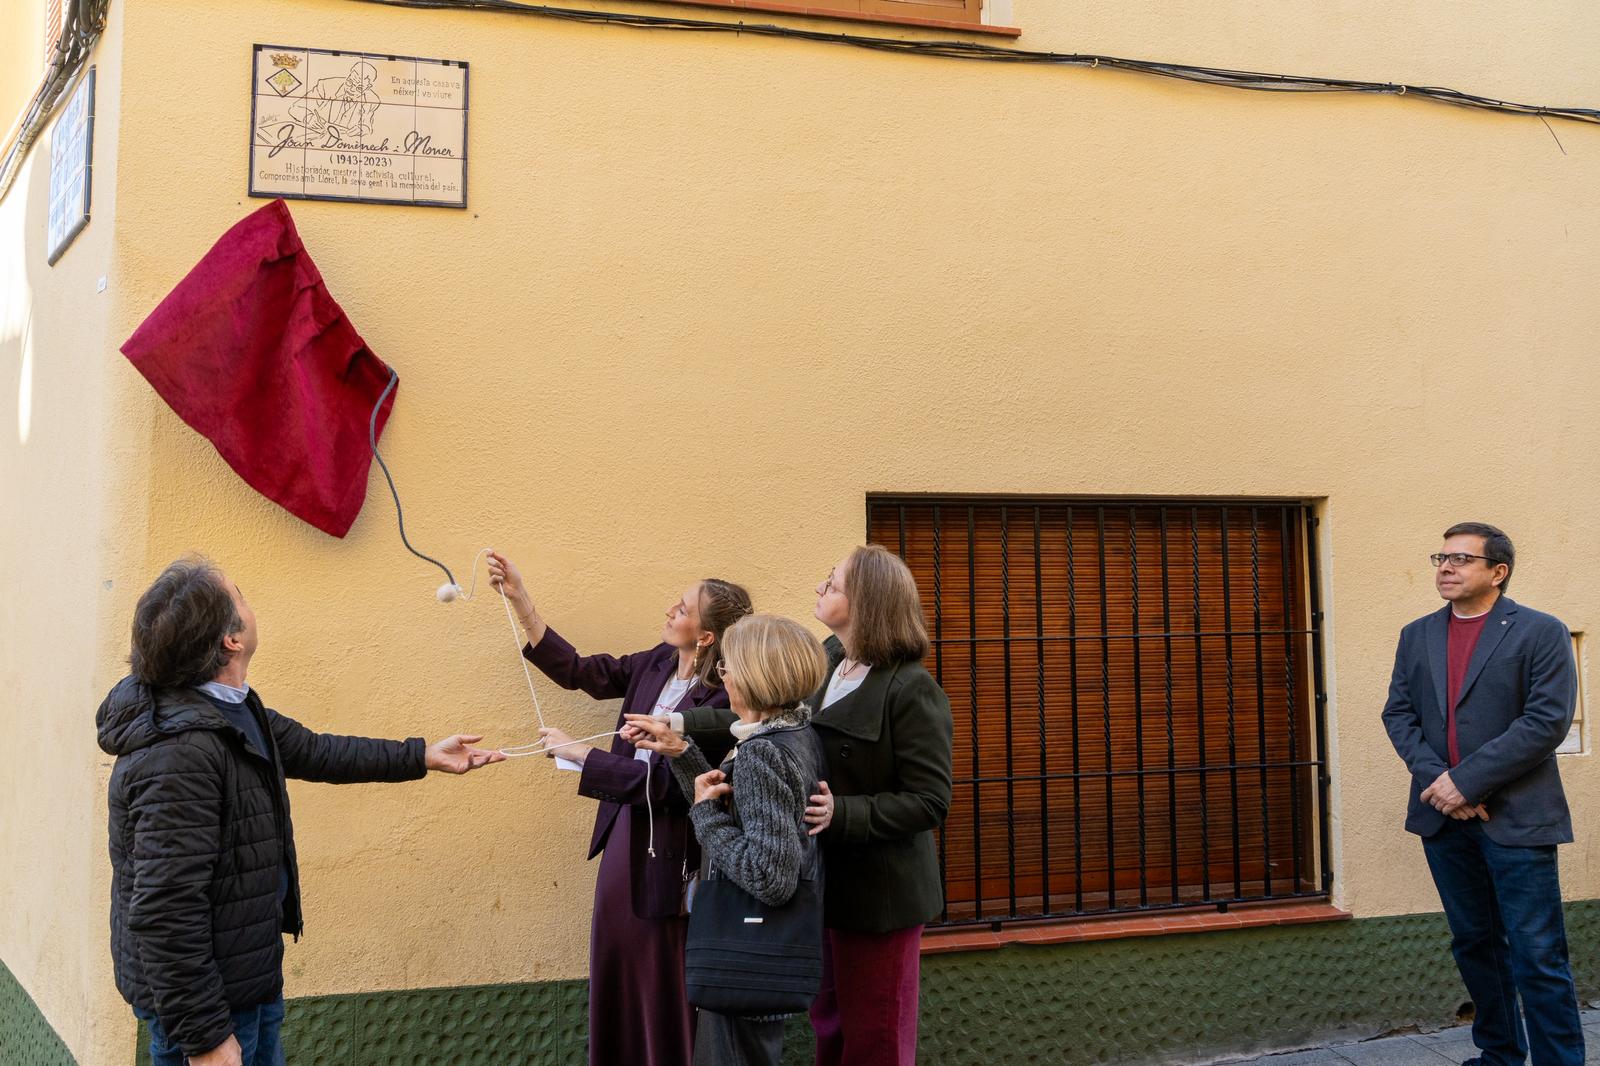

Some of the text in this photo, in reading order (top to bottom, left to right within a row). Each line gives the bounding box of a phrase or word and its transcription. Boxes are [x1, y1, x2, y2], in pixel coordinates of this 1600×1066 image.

[391, 75, 400, 84] En
[402, 77, 430, 87] aquesta
[432, 80, 449, 88] casa
[422, 90, 431, 98] va
[432, 90, 452, 99] viure
[268, 124, 314, 158] Joan
[321, 125, 389, 151] Domènech
[404, 130, 455, 157] Moner
[330, 153, 392, 167] (1943-2023)
[285, 162, 331, 175] Historiador,
[333, 168, 357, 177] mestre
[366, 169, 394, 179] activista
[398, 171, 435, 181] cultural.
[301, 174, 315, 182] amb
[318, 174, 340, 184] Lloret,
[341, 176, 348, 184] la
[350, 178, 367, 186] seva
[368, 180, 383, 189] gent
[391, 179, 398, 188] la
[399, 181, 430, 190] memòria
[430, 181, 440, 190] del
